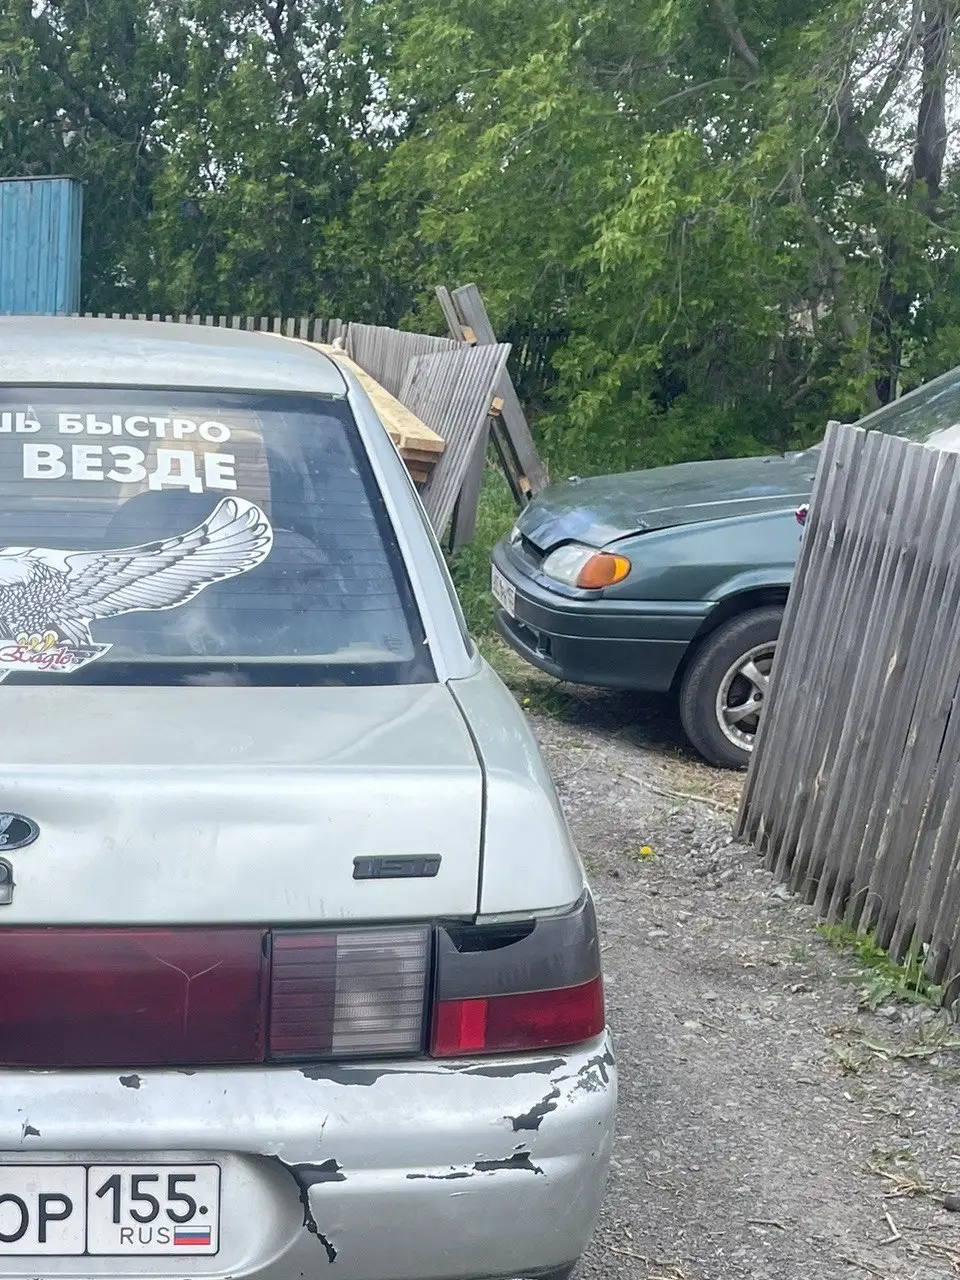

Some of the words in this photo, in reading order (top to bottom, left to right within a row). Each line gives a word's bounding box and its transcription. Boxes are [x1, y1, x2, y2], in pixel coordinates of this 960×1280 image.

[58, 412, 232, 443] БЫСТРО
[23, 443, 238, 494] ВЕЗДЕ
[95, 1174, 197, 1224] 155
[120, 1226, 171, 1245] RUS
